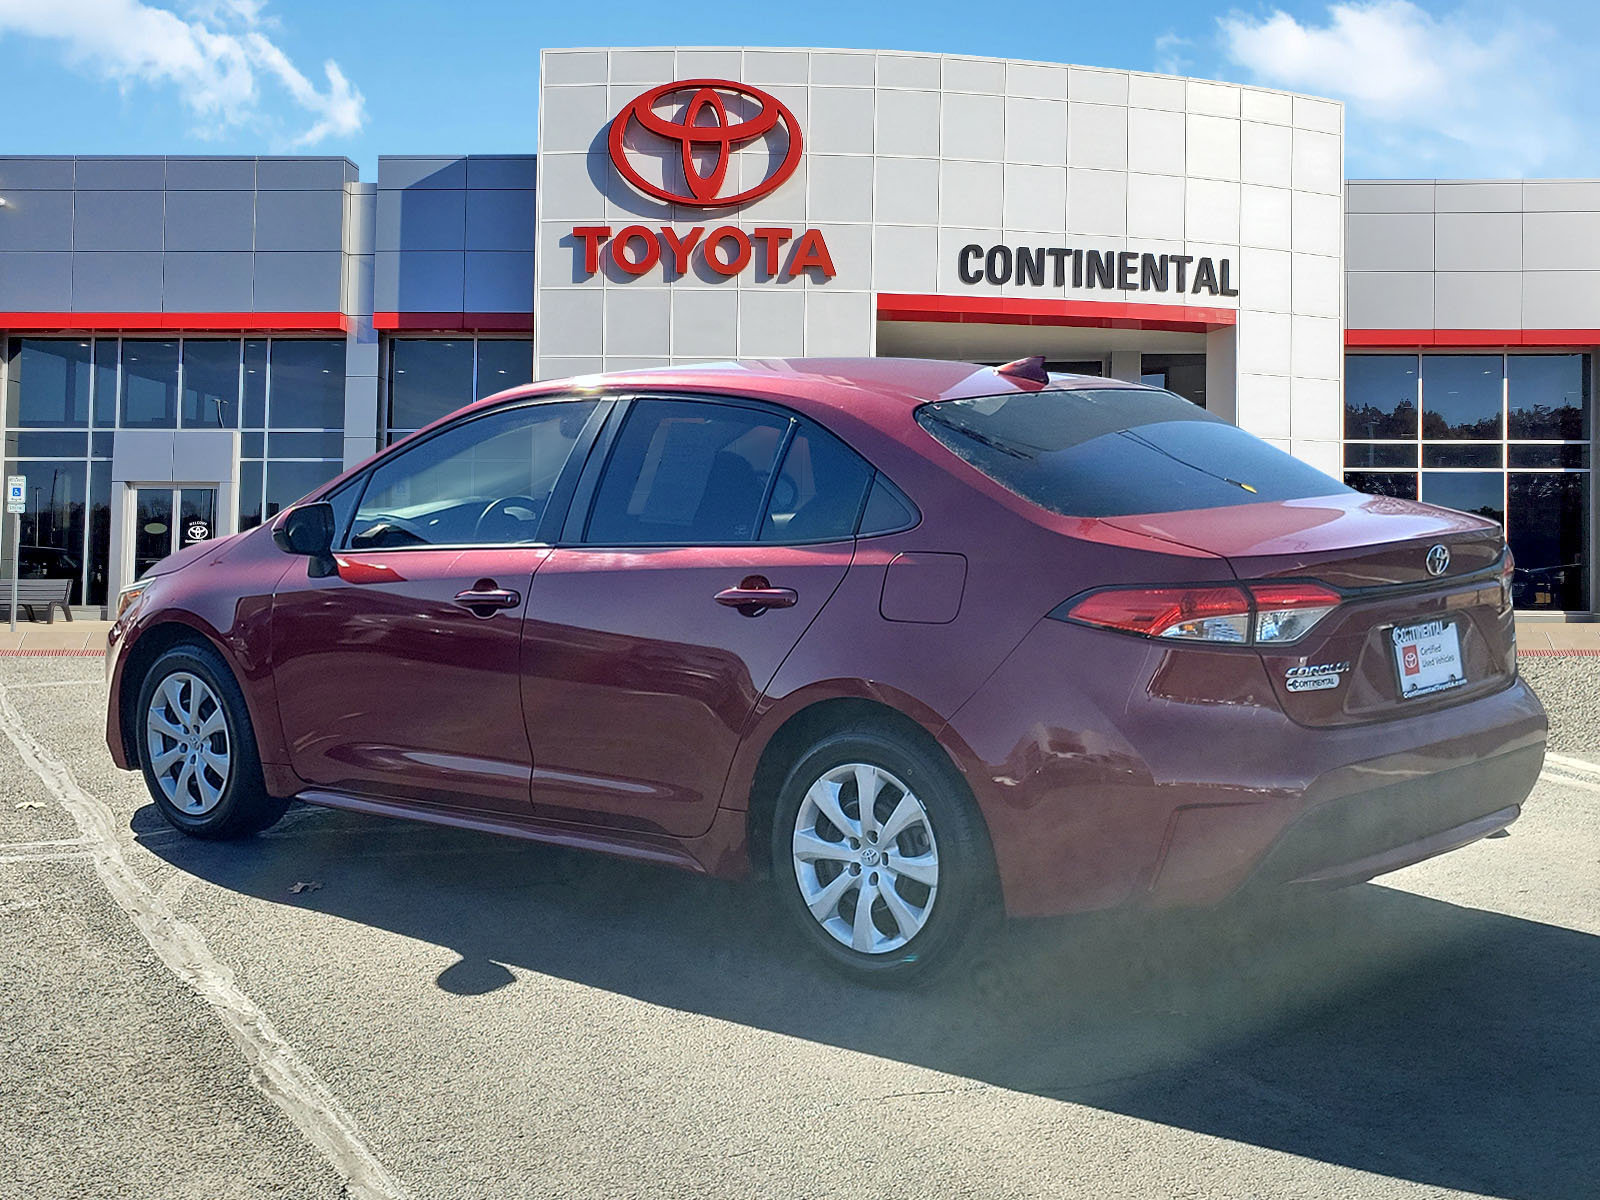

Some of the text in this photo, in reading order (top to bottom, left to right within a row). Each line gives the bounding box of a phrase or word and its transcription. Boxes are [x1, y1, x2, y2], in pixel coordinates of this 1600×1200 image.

[573, 225, 837, 277] TOYOTA
[958, 244, 1239, 297] CONTINENTAL
[1420, 643, 1442, 656] Certified
[1285, 661, 1350, 678] COROLLA
[1421, 654, 1455, 668] Used Vehicles
